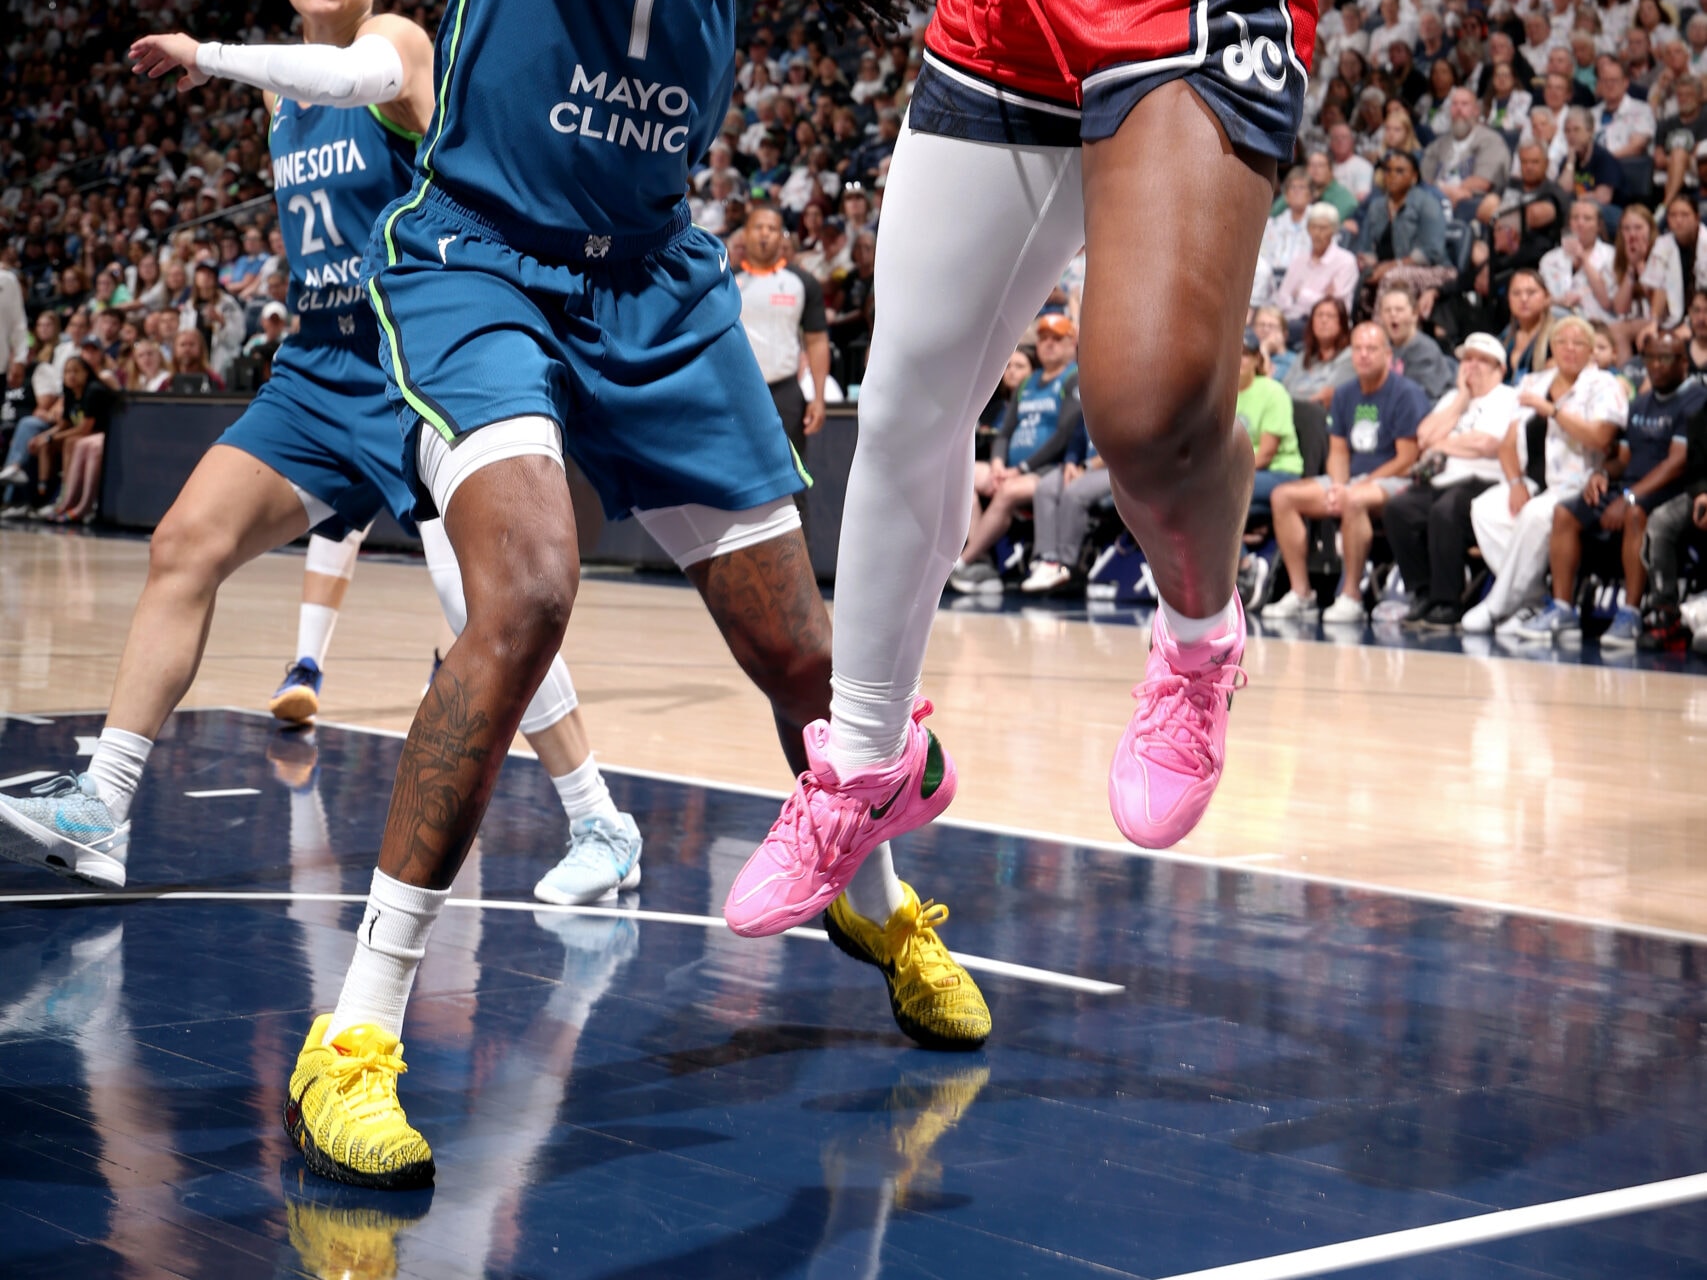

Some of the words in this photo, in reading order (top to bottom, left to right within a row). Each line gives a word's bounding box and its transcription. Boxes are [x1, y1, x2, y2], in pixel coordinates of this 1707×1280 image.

[569, 63, 689, 117] MAYO
[550, 100, 689, 154] CLINIC
[288, 188, 345, 257] 21
[297, 284, 366, 312] CLINI
